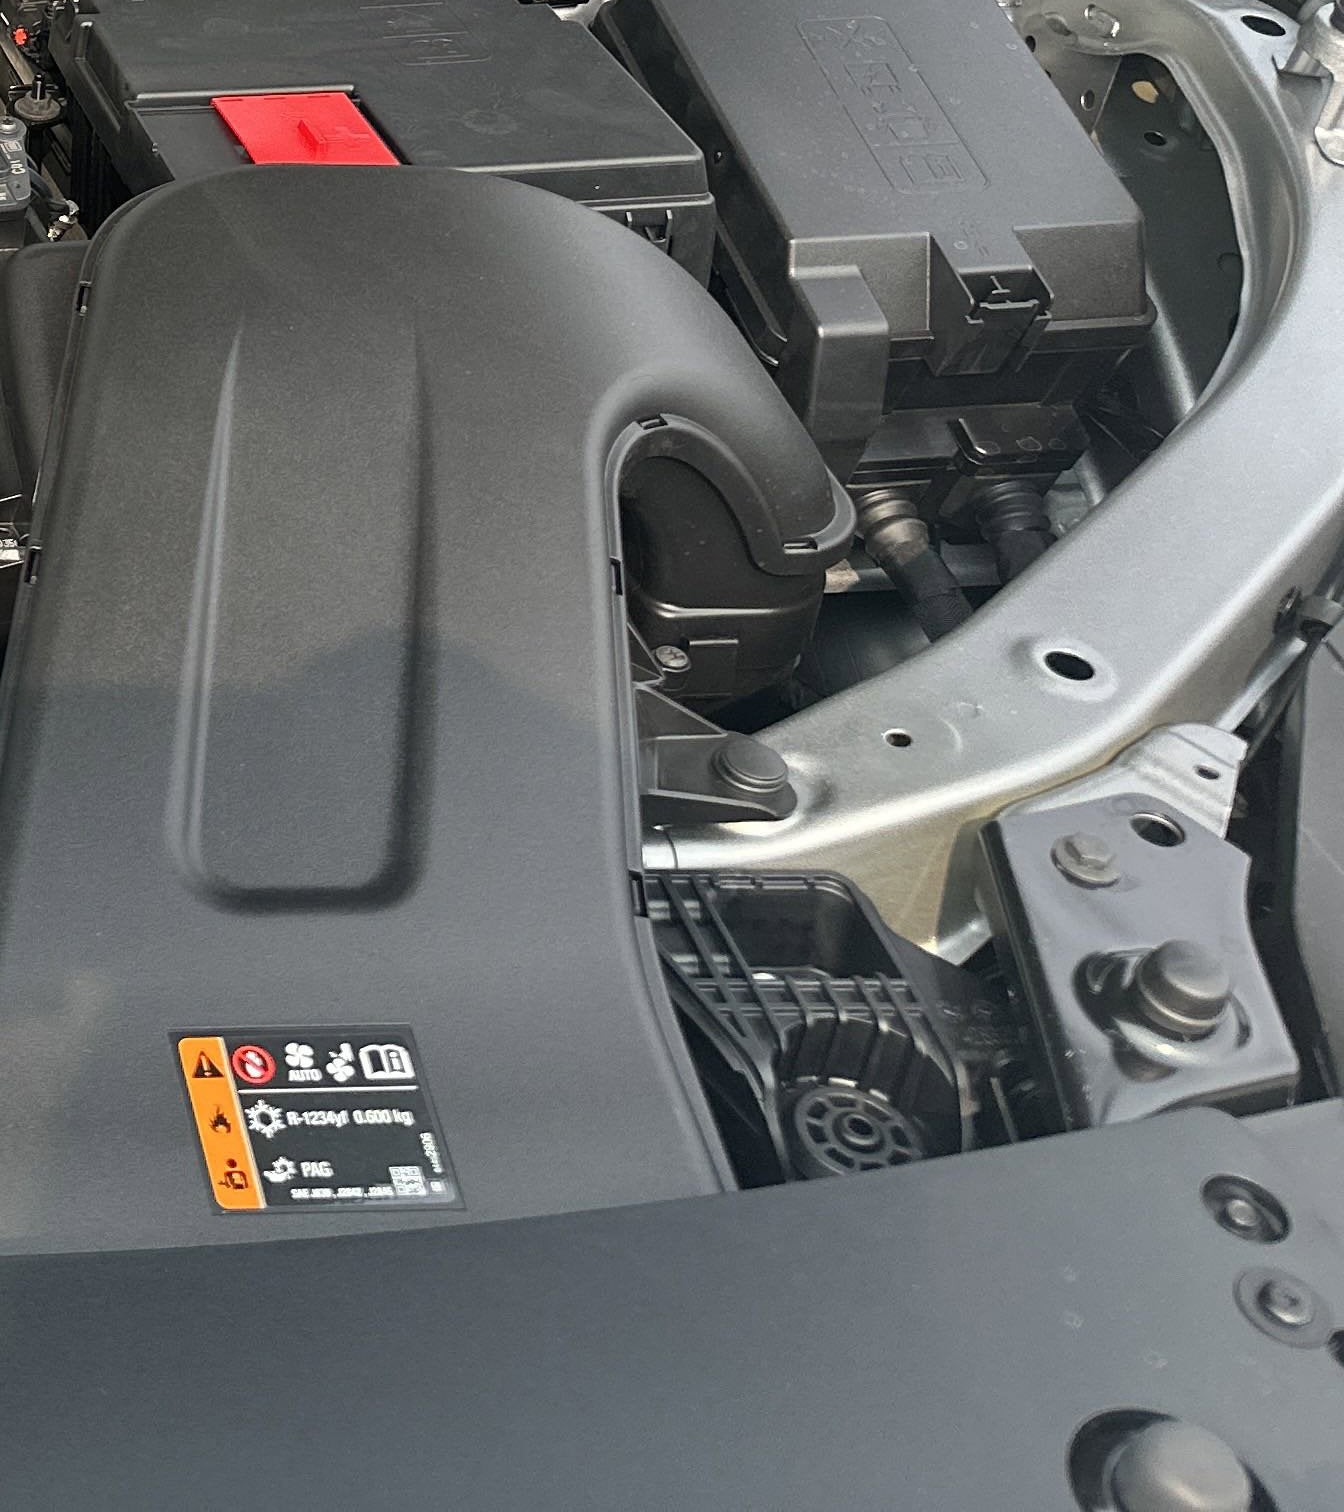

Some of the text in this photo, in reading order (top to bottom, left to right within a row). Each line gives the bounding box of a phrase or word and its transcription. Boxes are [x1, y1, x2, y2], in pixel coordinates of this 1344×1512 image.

[288, 1069, 323, 1082] AUTO
[286, 1110, 351, 1128] R-1234yf
[353, 1109, 392, 1125] 0.600
[300, 1161, 334, 1178] PAG
